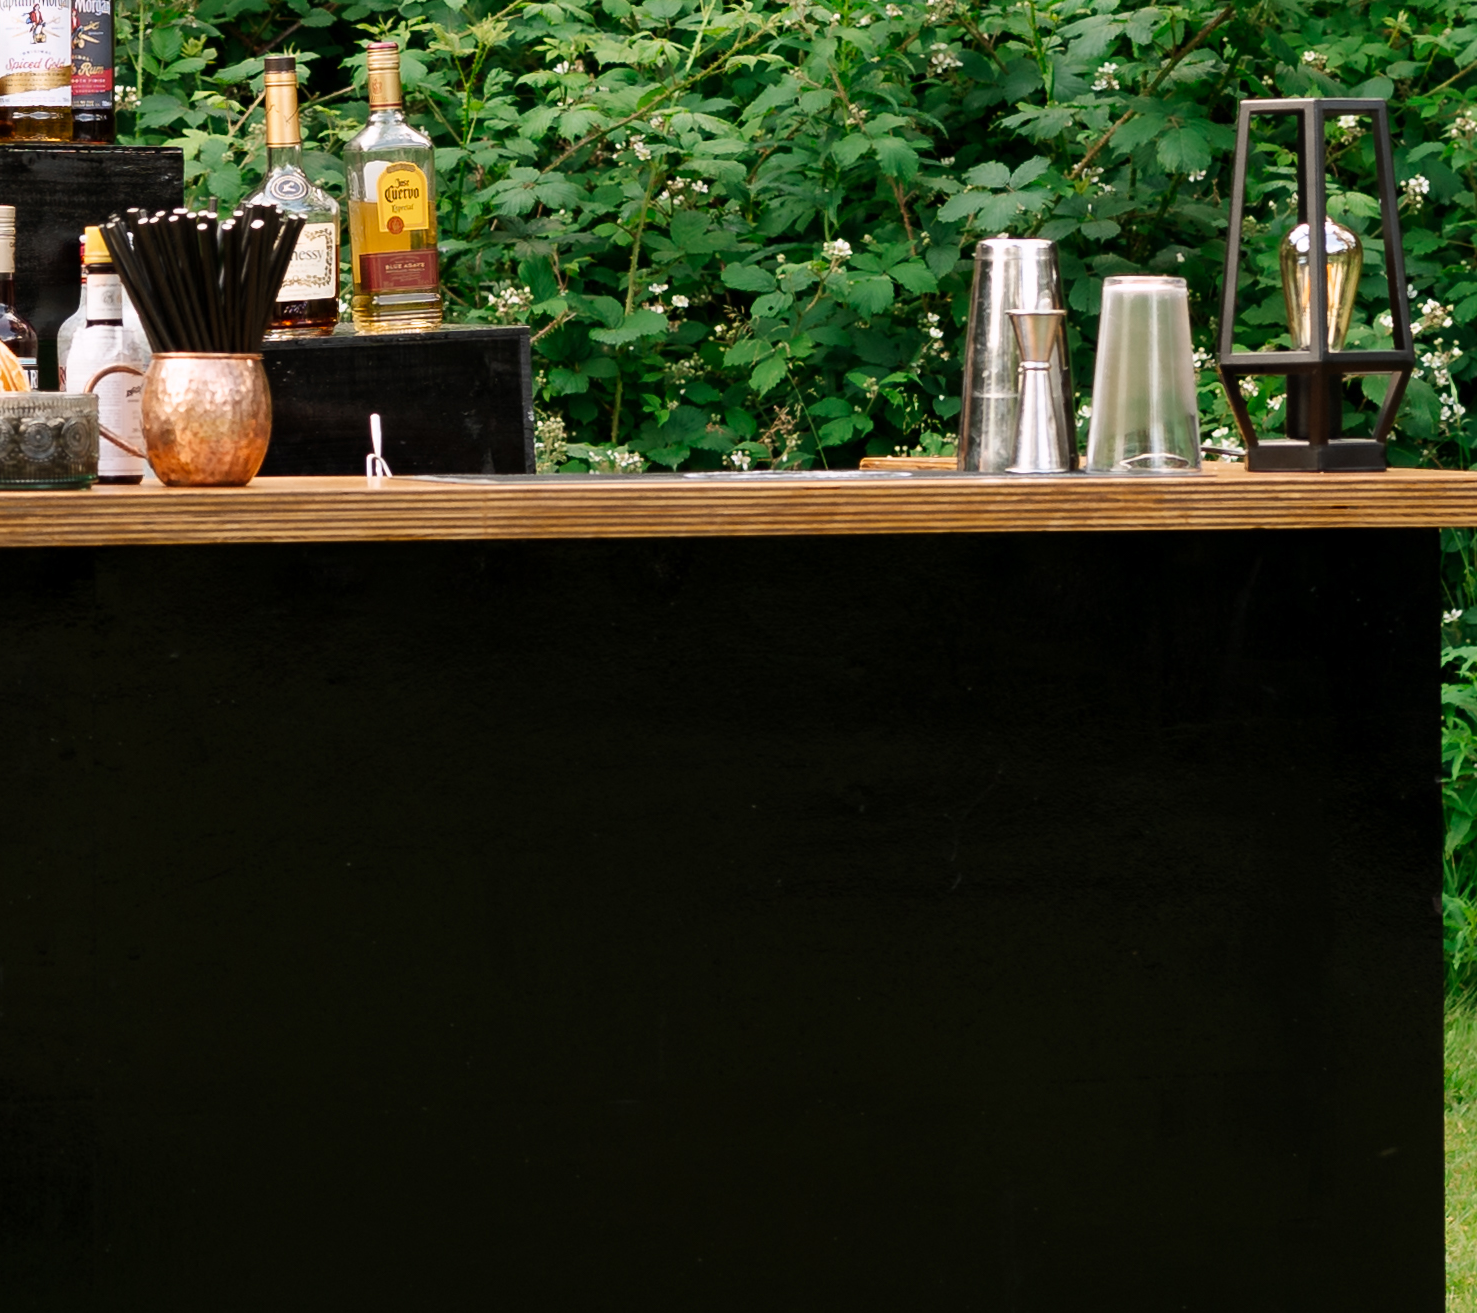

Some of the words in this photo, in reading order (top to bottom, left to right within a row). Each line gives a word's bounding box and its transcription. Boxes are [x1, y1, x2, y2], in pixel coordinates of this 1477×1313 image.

[5, 57, 43, 71] Spiced
[44, 56, 66, 71] Gold
[78, 62, 104, 77] Rum
[395, 178, 410, 188] Jose
[384, 185, 420, 203] Cuervo
[392, 203, 414, 213] Especial
